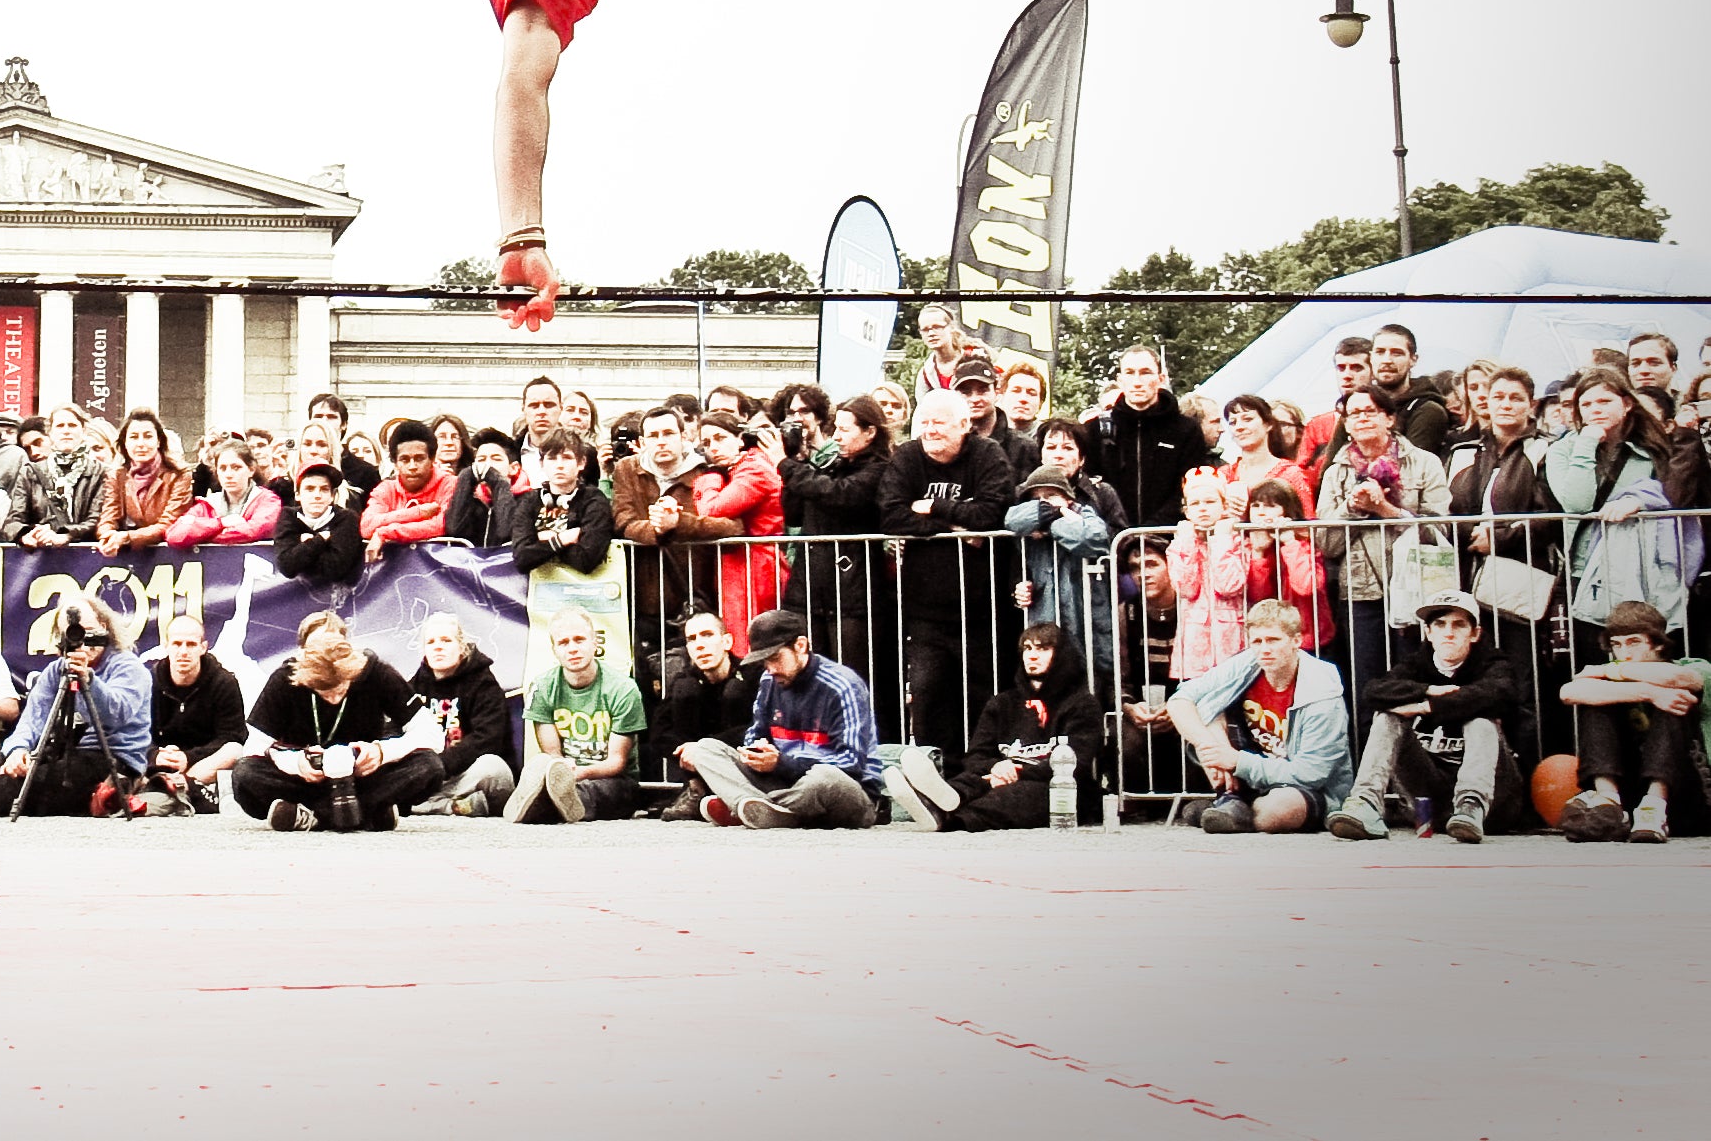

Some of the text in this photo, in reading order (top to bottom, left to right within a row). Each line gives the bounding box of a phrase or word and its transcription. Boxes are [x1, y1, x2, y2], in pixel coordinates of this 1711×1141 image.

[3, 315, 24, 417] THEATER
[87, 328, 112, 413] Ägineten
[26, 561, 204, 656] 2011
[553, 707, 612, 743] 2011
